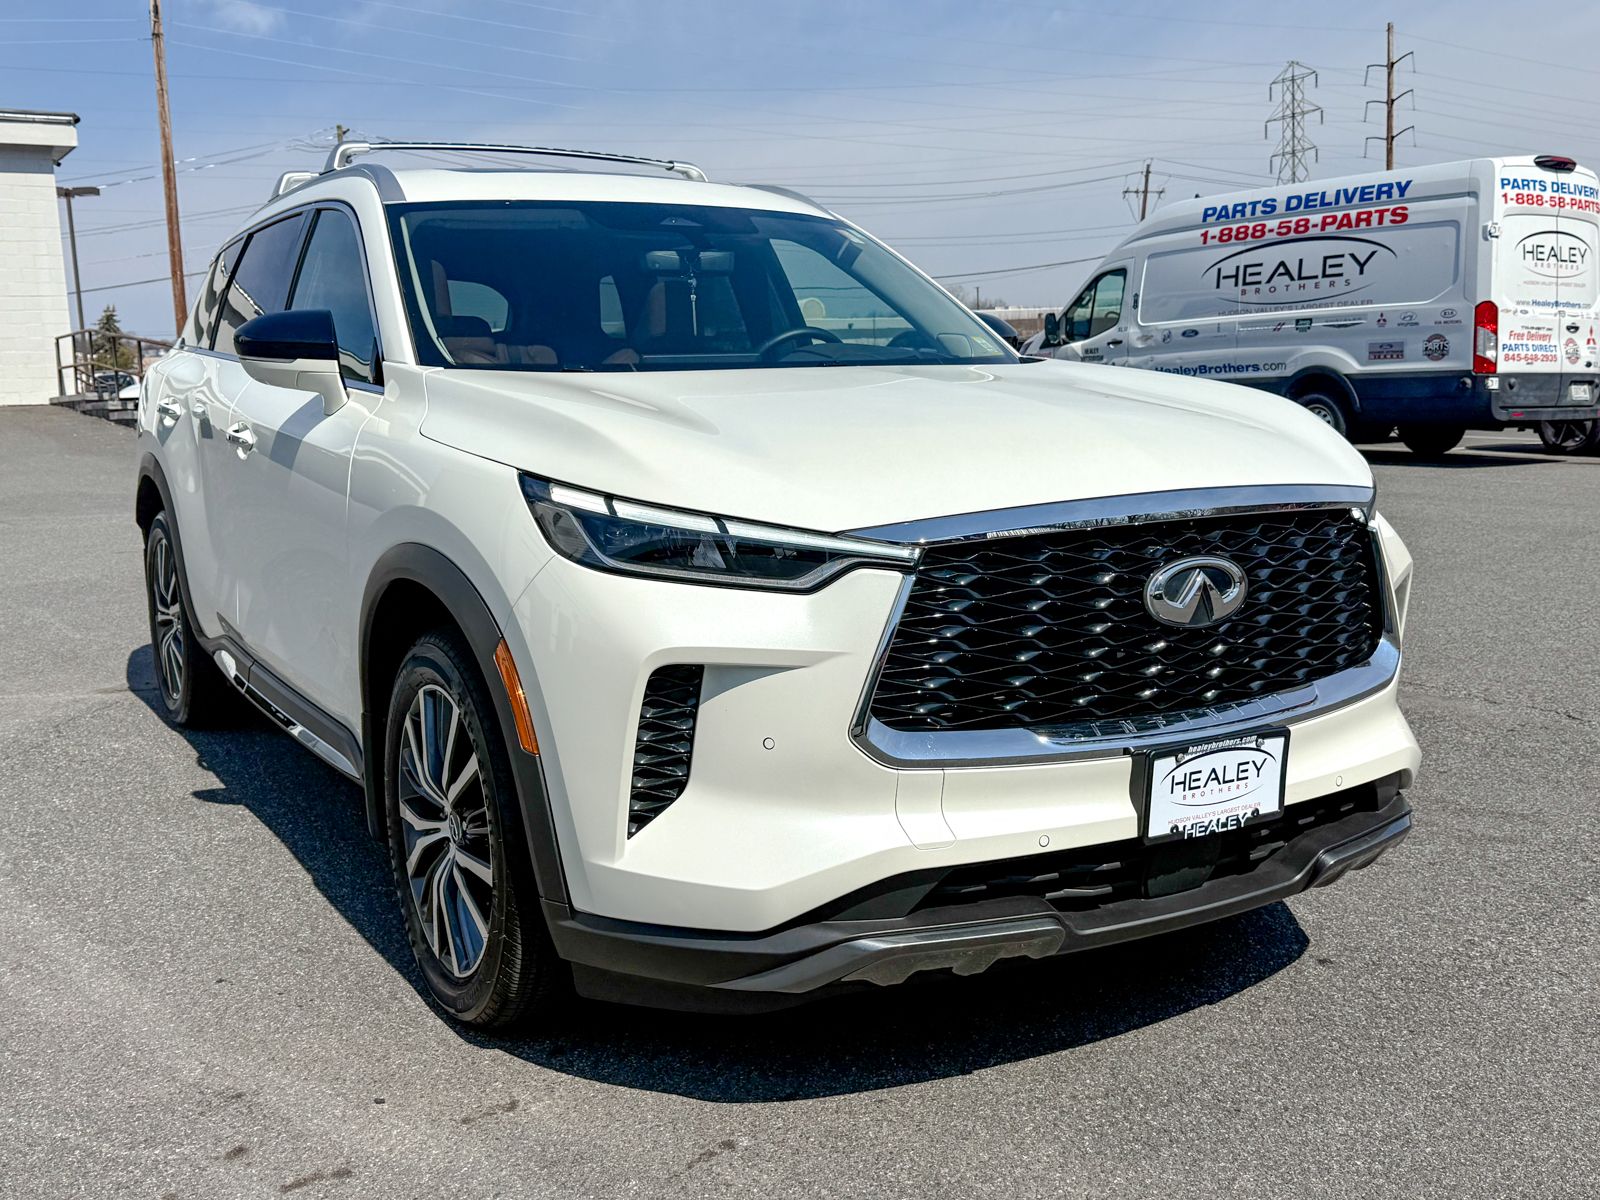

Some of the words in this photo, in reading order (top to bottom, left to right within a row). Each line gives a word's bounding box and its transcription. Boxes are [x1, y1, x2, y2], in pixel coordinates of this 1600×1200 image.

[1500, 178, 1547, 192] PARTS
[1551, 181, 1599, 199] DELIVERY
[1202, 198, 1278, 223] PARTS
[1284, 179, 1413, 212] DELIVERY
[1501, 192, 1600, 213] 1-888-58-PARTS
[1200, 206, 1409, 245] 1-888-58-PARTS
[1522, 243, 1588, 264] HEALEY
[1215, 250, 1378, 289] HEALEY
[1240, 279, 1352, 296] BROTHERS
[1295, 301, 1336, 310] LARGEST
[1336, 299, 1374, 307] DEALER
[1502, 343, 1530, 352] PARTS
[1531, 344, 1557, 353] DIRECT
[1187, 735, 1258, 753] healeybrothers.com
[1170, 757, 1268, 794] HEALEY
[1182, 782, 1249, 800] BROTHERS
[1168, 815, 1191, 825] HUDSON
[1192, 810, 1216, 821] VALLEY'S
[1216, 806, 1241, 816] LARGEST
[1241, 801, 1261, 811] DEALER
[1184, 811, 1248, 839] HEALEY
